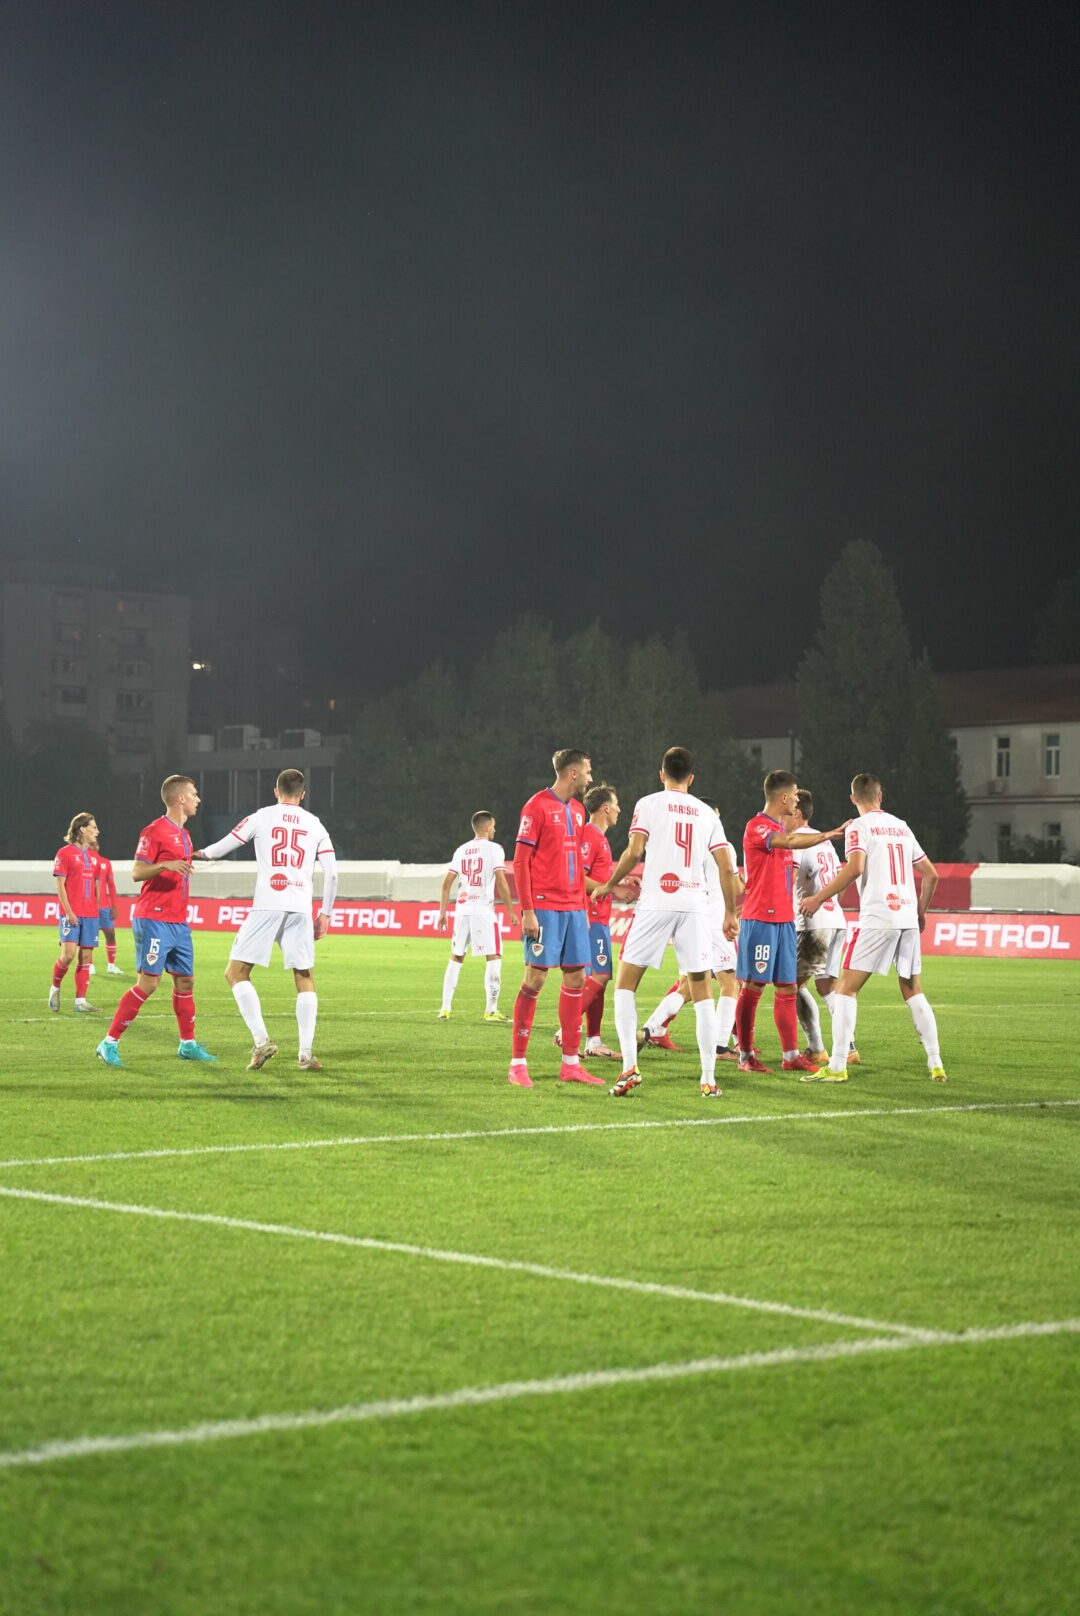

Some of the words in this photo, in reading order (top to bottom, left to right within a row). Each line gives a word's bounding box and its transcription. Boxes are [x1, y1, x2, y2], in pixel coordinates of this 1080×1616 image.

[271, 826, 308, 869] 25
[675, 822, 693, 868] 4
[461, 857, 483, 887] 42
[887, 843, 906, 885] 11
[149, 938, 160, 954] 15
[597, 939, 604, 953] 7
[933, 922, 1071, 949] PETROL
[755, 945, 770, 960] 88
